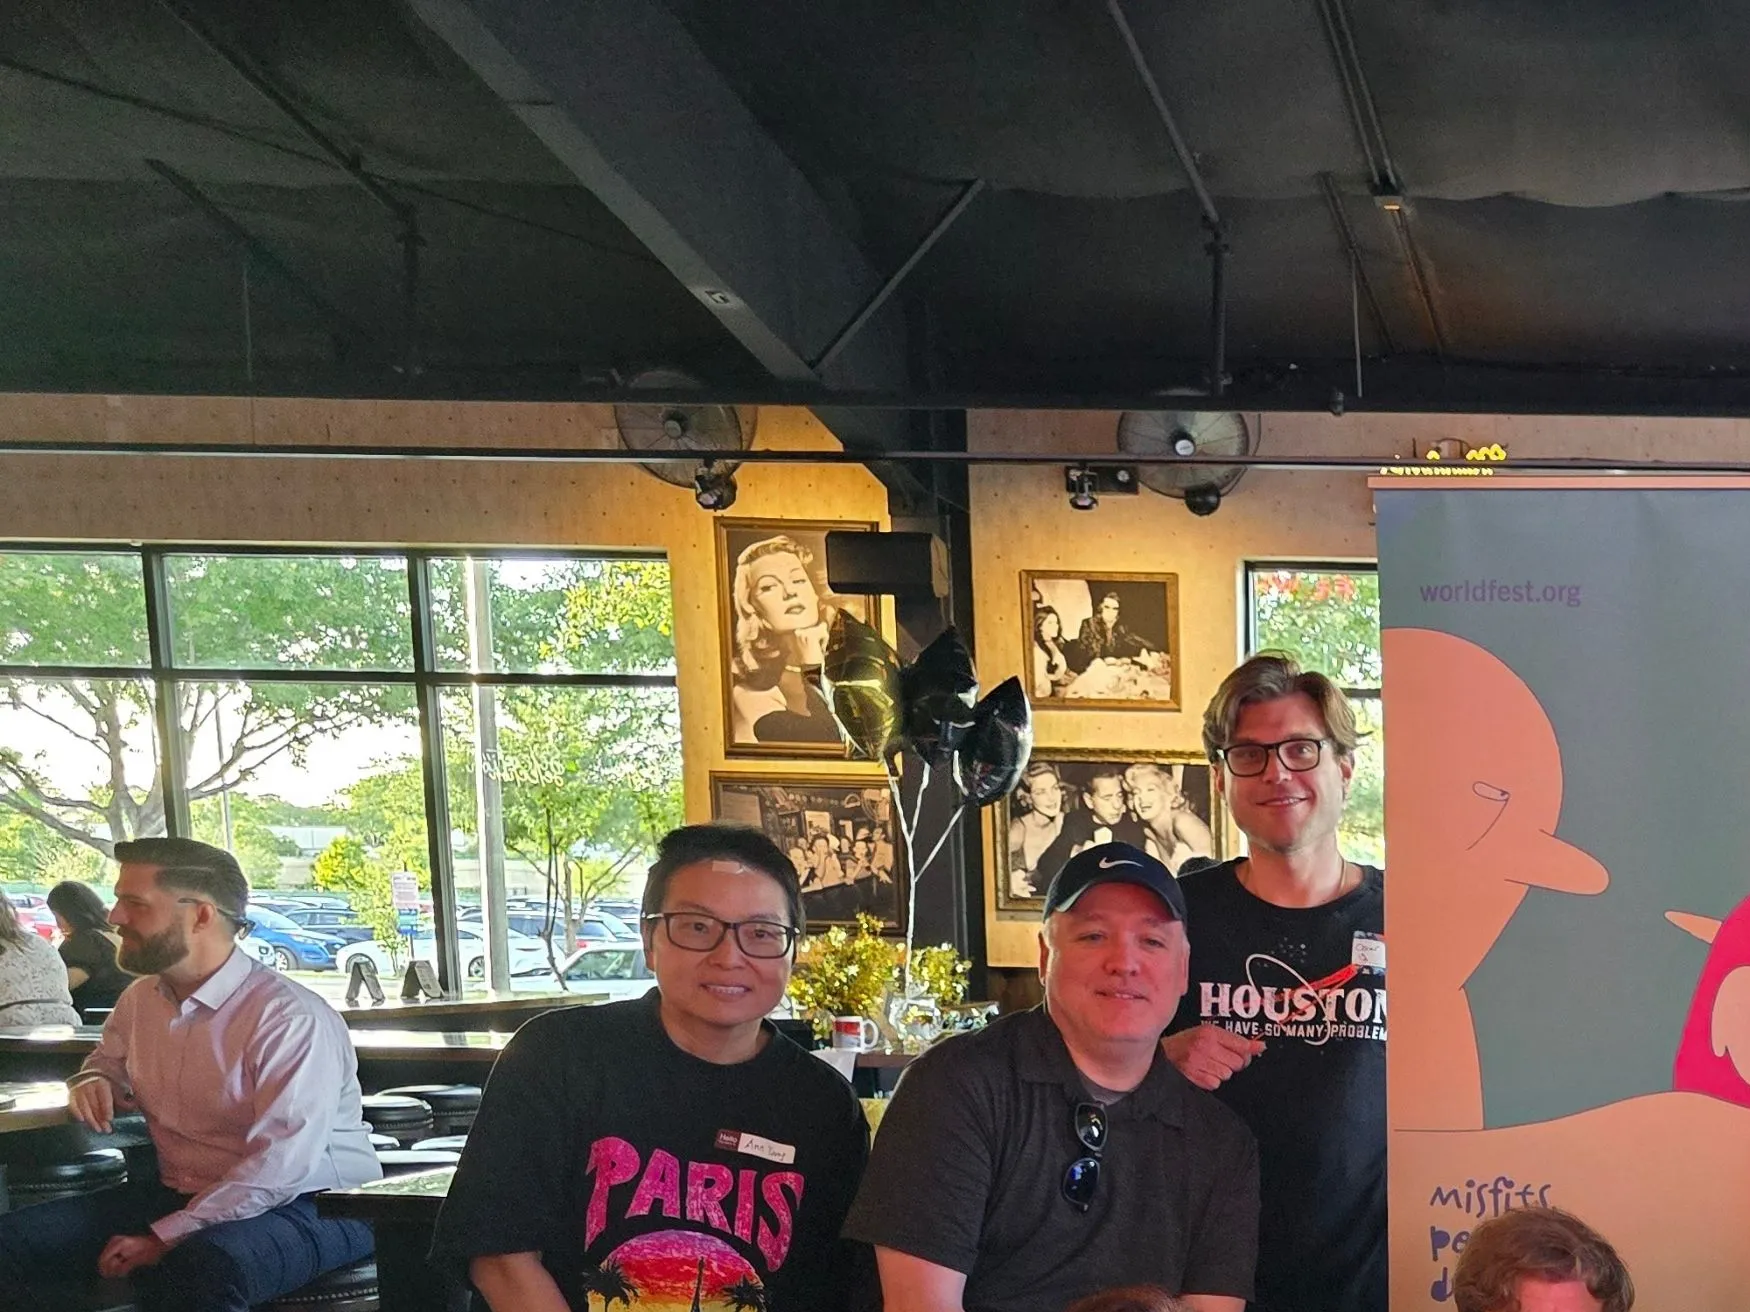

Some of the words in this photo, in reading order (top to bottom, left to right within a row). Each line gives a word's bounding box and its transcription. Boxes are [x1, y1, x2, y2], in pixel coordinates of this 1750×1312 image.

[1419, 579, 1582, 608] worldfest.org
[1225, 1021, 1263, 1036] HAVE
[1264, 1022, 1281, 1036] SO
[1285, 1022, 1326, 1038] MANY
[585, 1136, 804, 1272] PARIS
